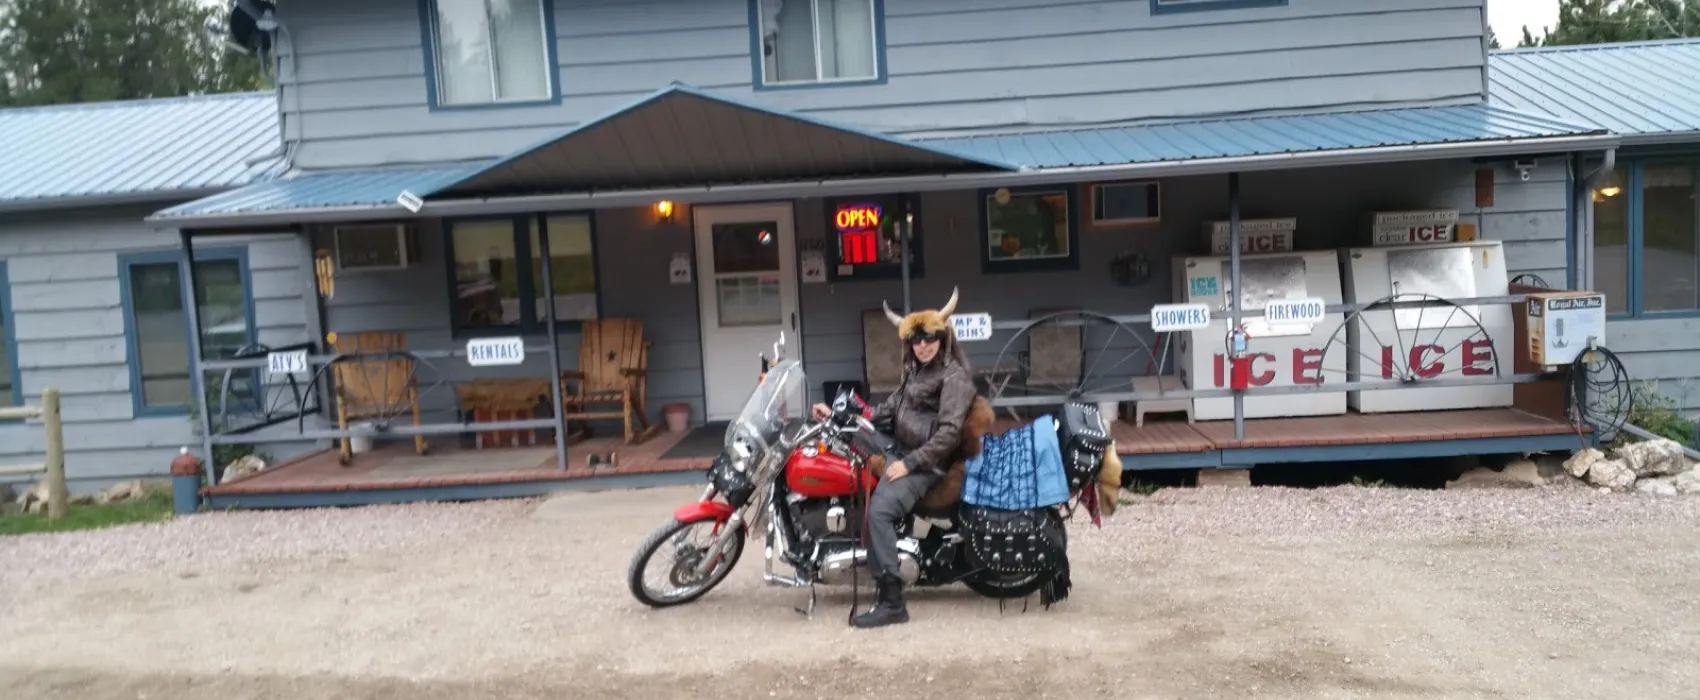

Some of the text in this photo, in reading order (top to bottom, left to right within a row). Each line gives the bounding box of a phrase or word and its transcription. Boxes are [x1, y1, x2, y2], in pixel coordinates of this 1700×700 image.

[836, 208, 878, 228] OPEN
[1409, 224, 1447, 242] ICE
[1247, 233, 1286, 252] ICE
[1191, 276, 1217, 289] ICE
[1155, 307, 1207, 327] SHOWERS
[1268, 302, 1321, 321] FIREWOOD
[955, 317, 986, 327] MP &
[957, 328, 985, 338] BINS
[472, 343, 519, 360] RENTALS
[1382, 339, 1493, 379] ICE
[272, 354, 304, 370] ATV'S
[1213, 348, 1325, 387] ICE
